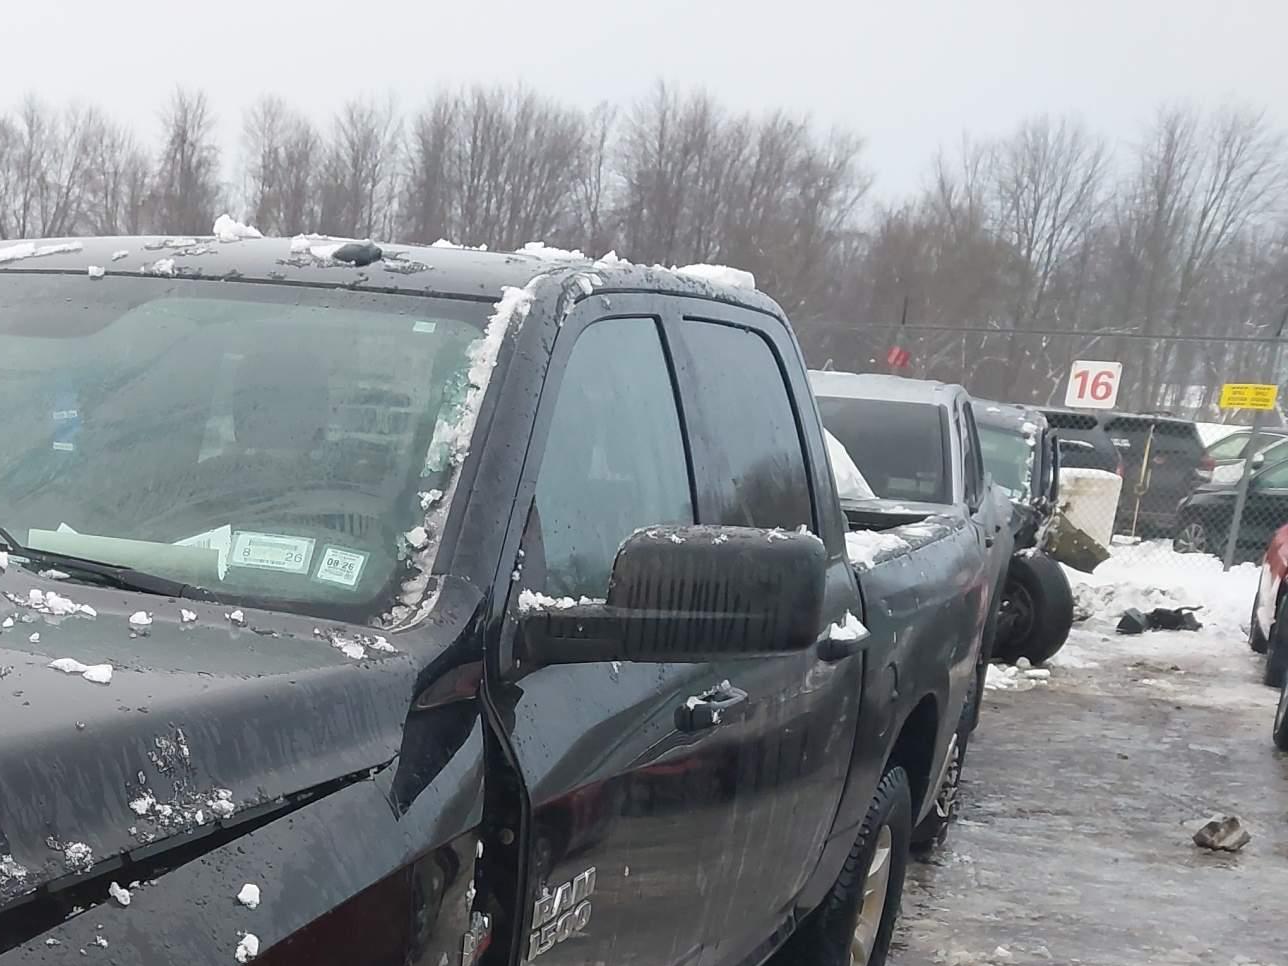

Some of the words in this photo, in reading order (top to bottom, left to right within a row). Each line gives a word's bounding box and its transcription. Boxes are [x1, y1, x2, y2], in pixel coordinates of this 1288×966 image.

[1074, 368, 1115, 401] 16
[285, 552, 303, 563] 26
[532, 867, 596, 929] RAM
[527, 900, 592, 961] 1500
